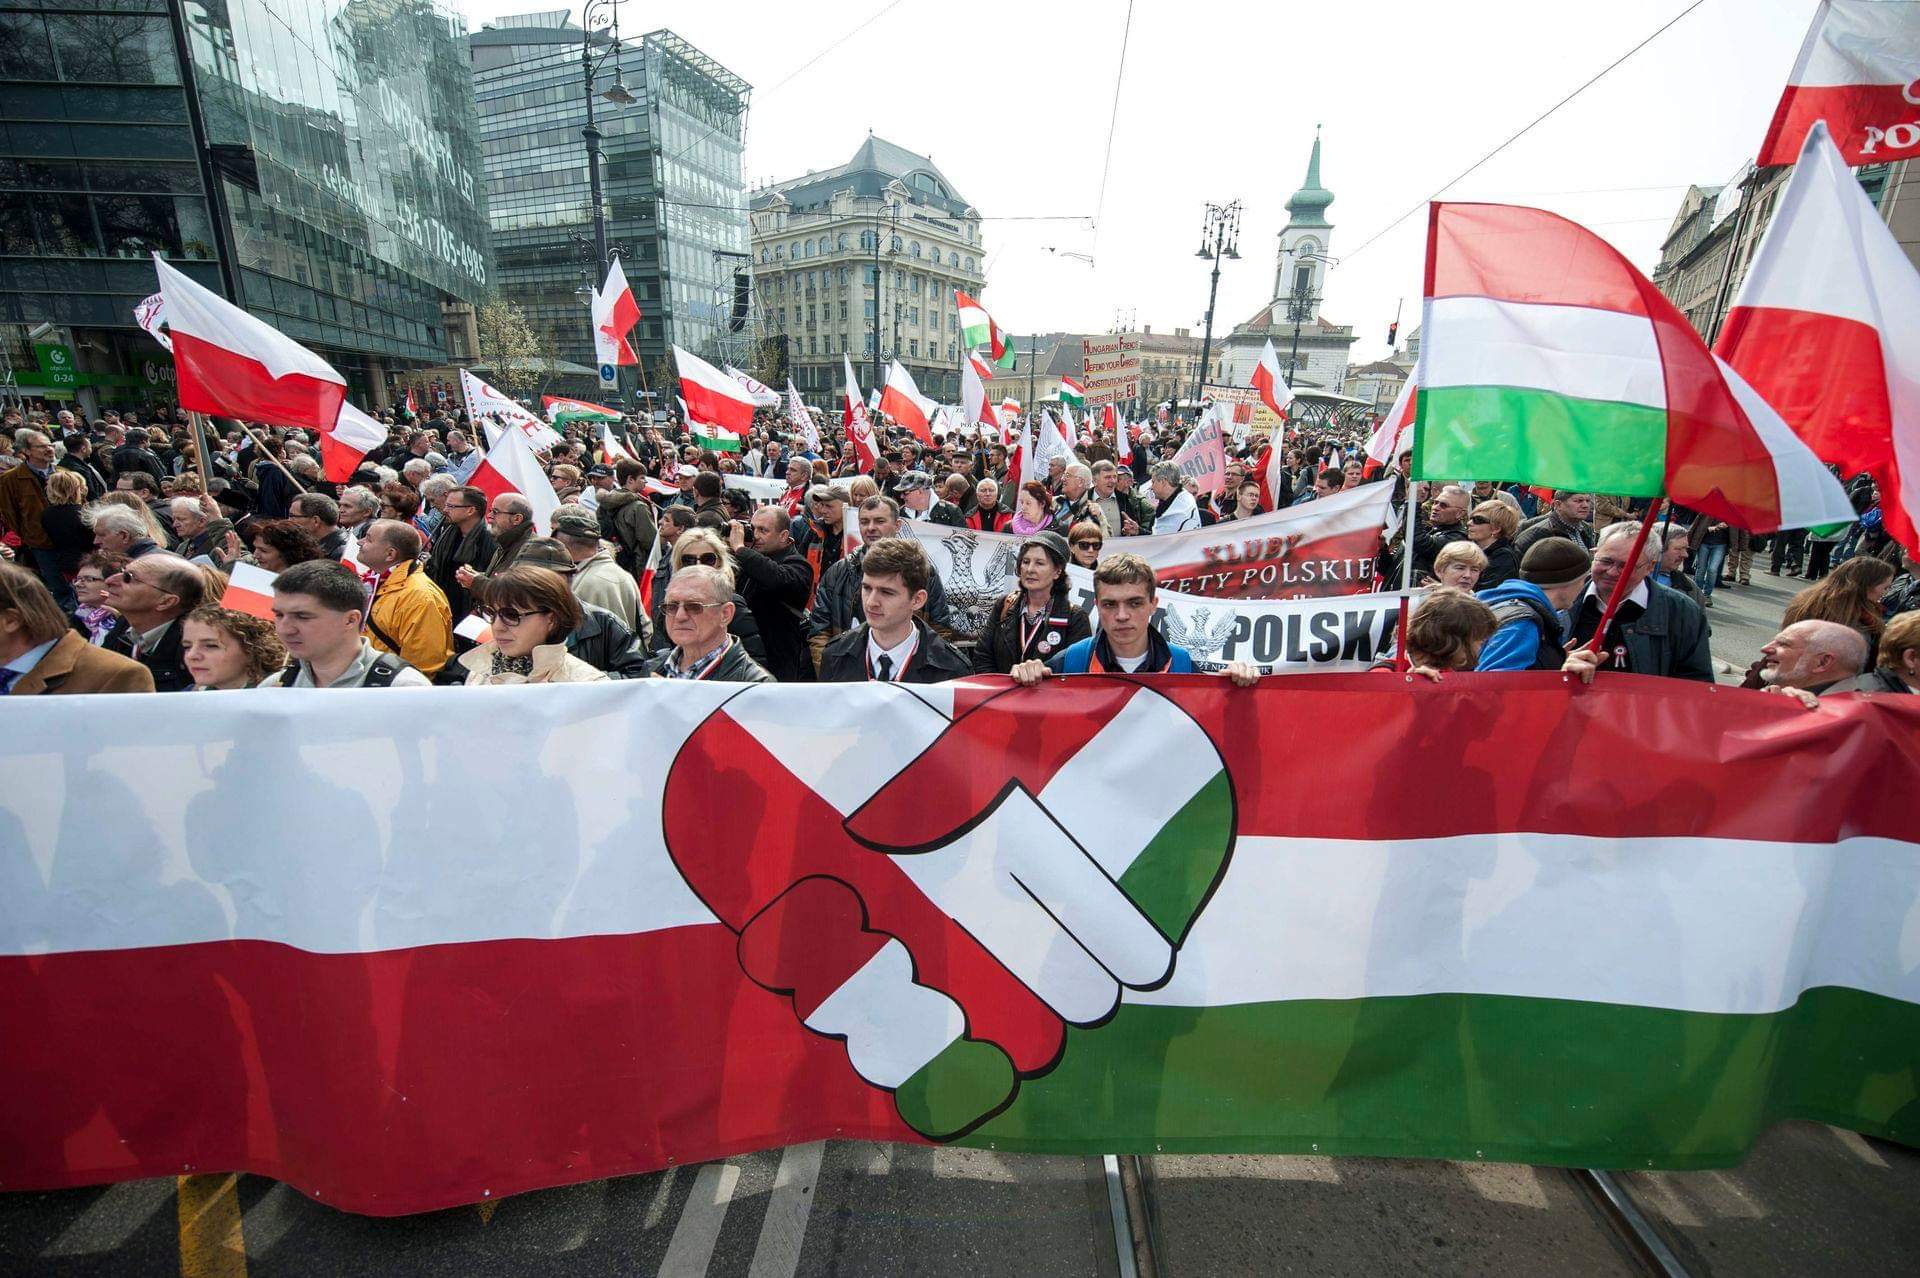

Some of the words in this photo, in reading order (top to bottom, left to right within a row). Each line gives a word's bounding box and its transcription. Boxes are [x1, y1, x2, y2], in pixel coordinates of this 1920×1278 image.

[1859, 121, 1920, 155] PO
[457, 162, 475, 206] LET
[396, 204, 422, 246] +36
[424, 219, 433, 251] 1
[431, 218, 486, 286] 785-4985
[1084, 340, 1118, 354] HUNGARIAN
[1084, 358, 1105, 372] DEFEND
[1105, 360, 1120, 370] YOUR
[53, 374, 74, 383] 0-24
[1085, 394, 1112, 405] ATHEISTS
[1117, 391, 1125, 399] OF
[1127, 383, 1136, 398] EU
[1203, 532, 1305, 563] KLUBY
